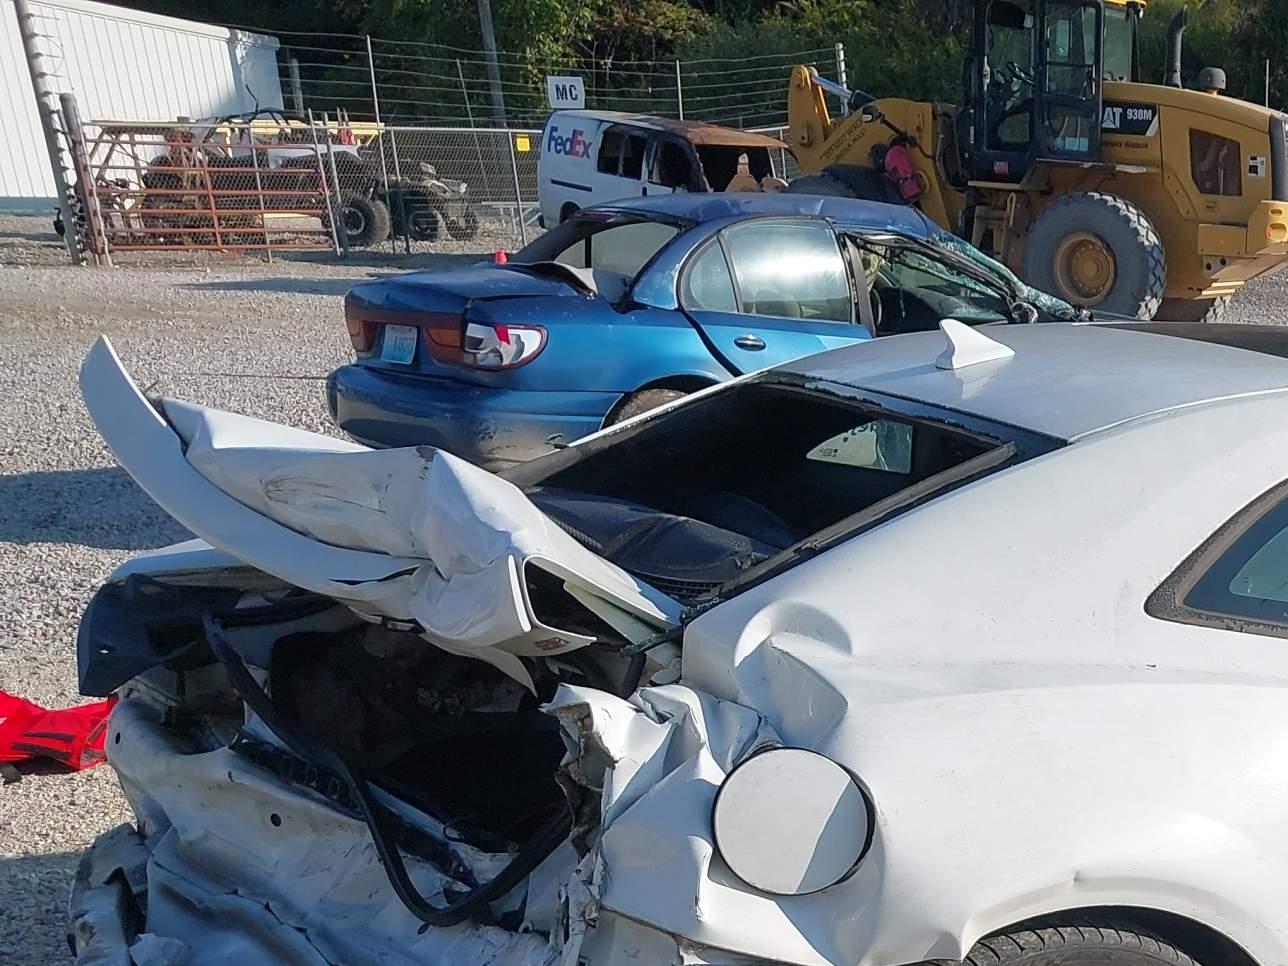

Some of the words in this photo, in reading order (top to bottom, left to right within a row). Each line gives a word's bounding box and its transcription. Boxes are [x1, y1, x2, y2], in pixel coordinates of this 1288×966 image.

[555, 84, 578, 101] MC
[1102, 107, 1123, 128] AT
[1127, 108, 1152, 120] 938M
[547, 125, 592, 159] FedEx
